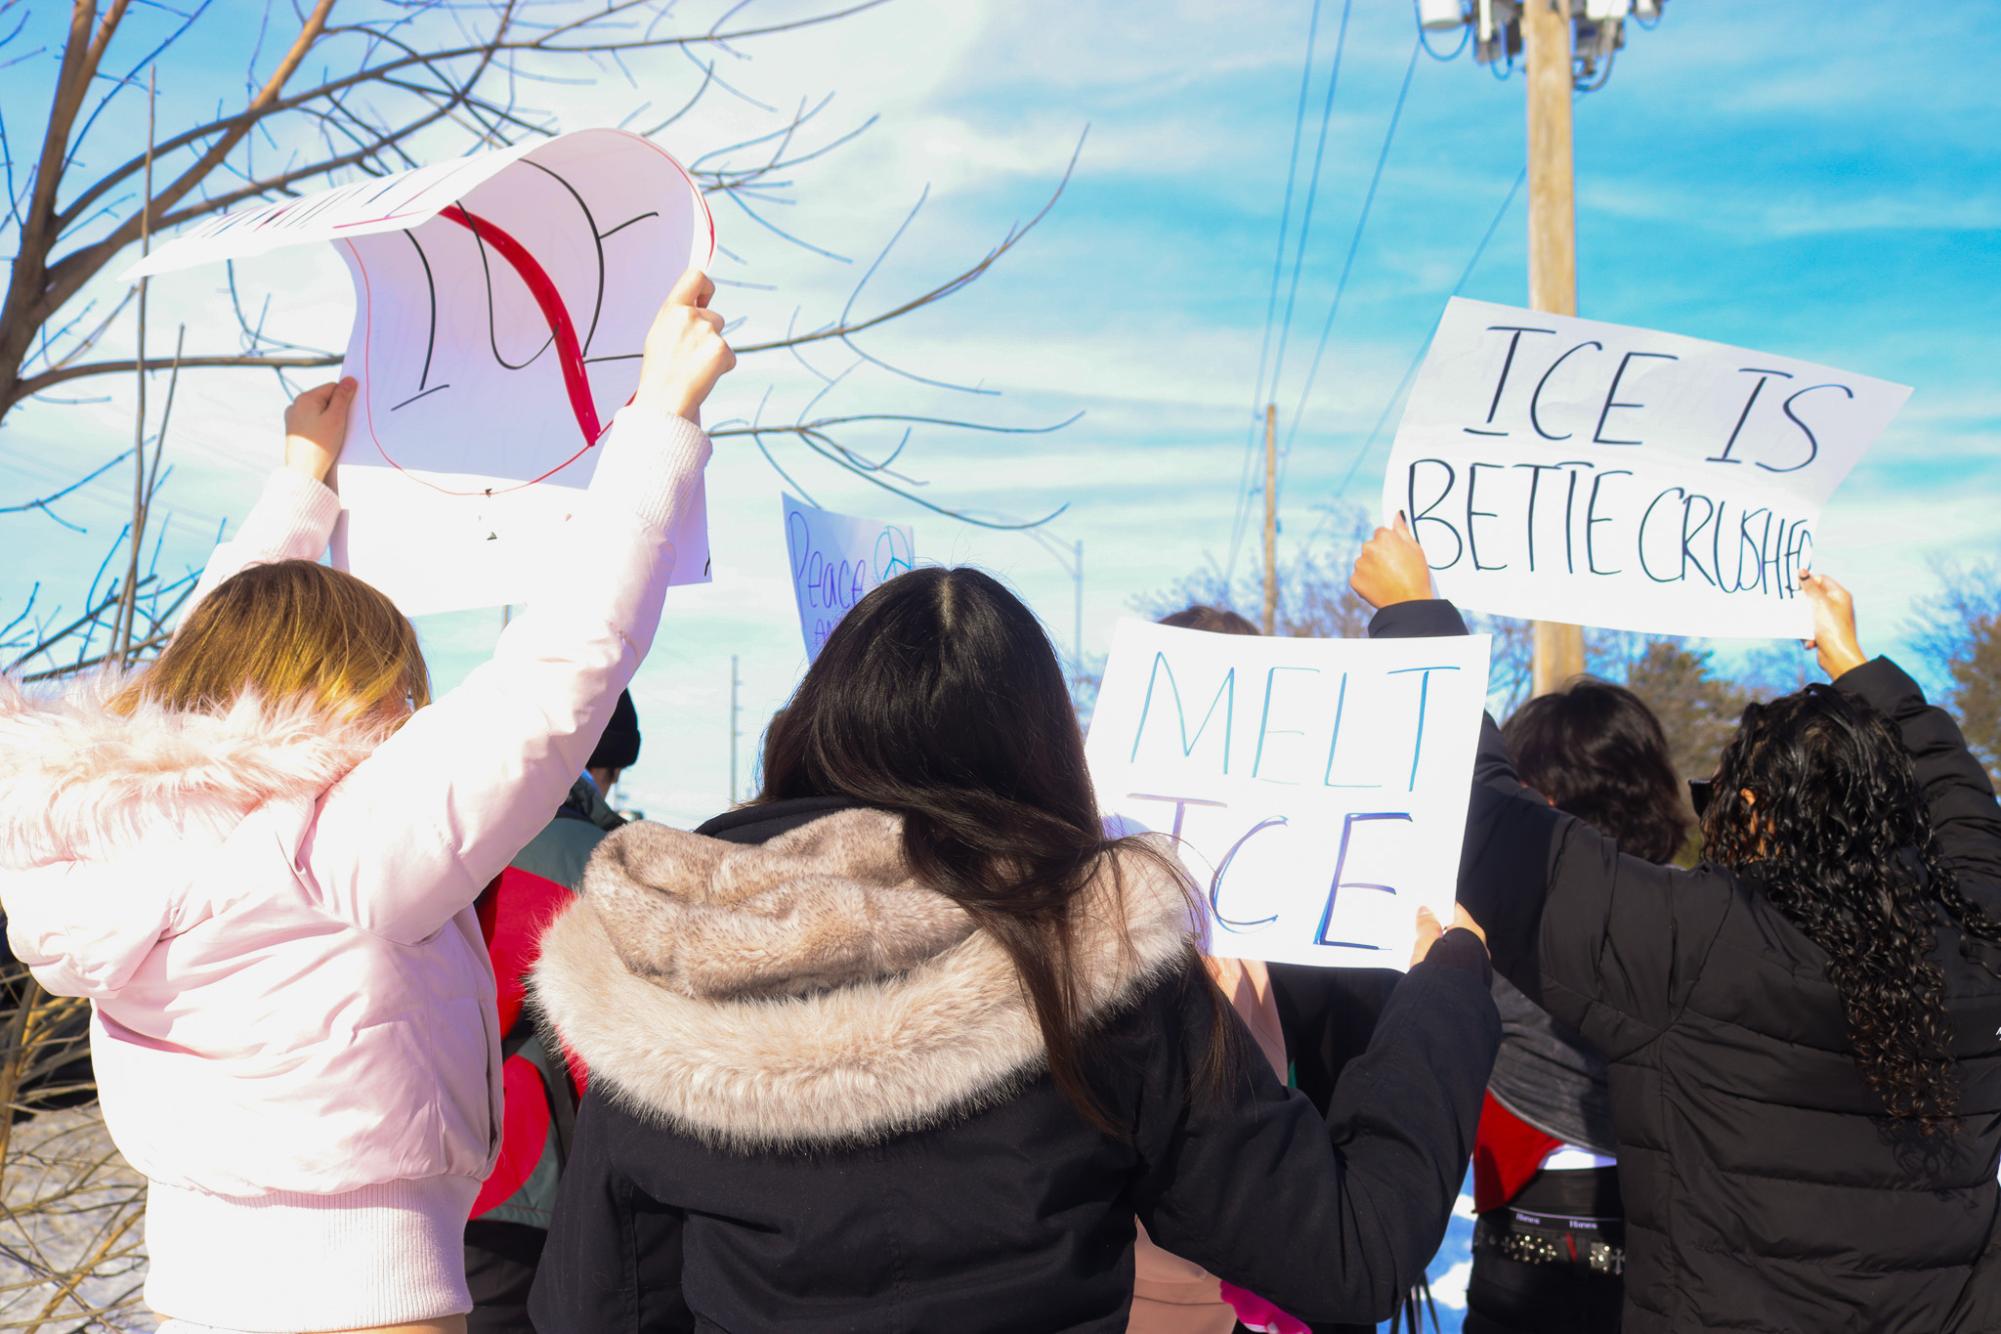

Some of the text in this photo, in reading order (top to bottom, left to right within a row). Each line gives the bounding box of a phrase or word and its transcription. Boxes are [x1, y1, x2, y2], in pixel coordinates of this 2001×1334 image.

[1463, 325, 1854, 473] ICE IS
[1408, 458, 1634, 576] BETTE
[1131, 650, 1461, 792] MELT
